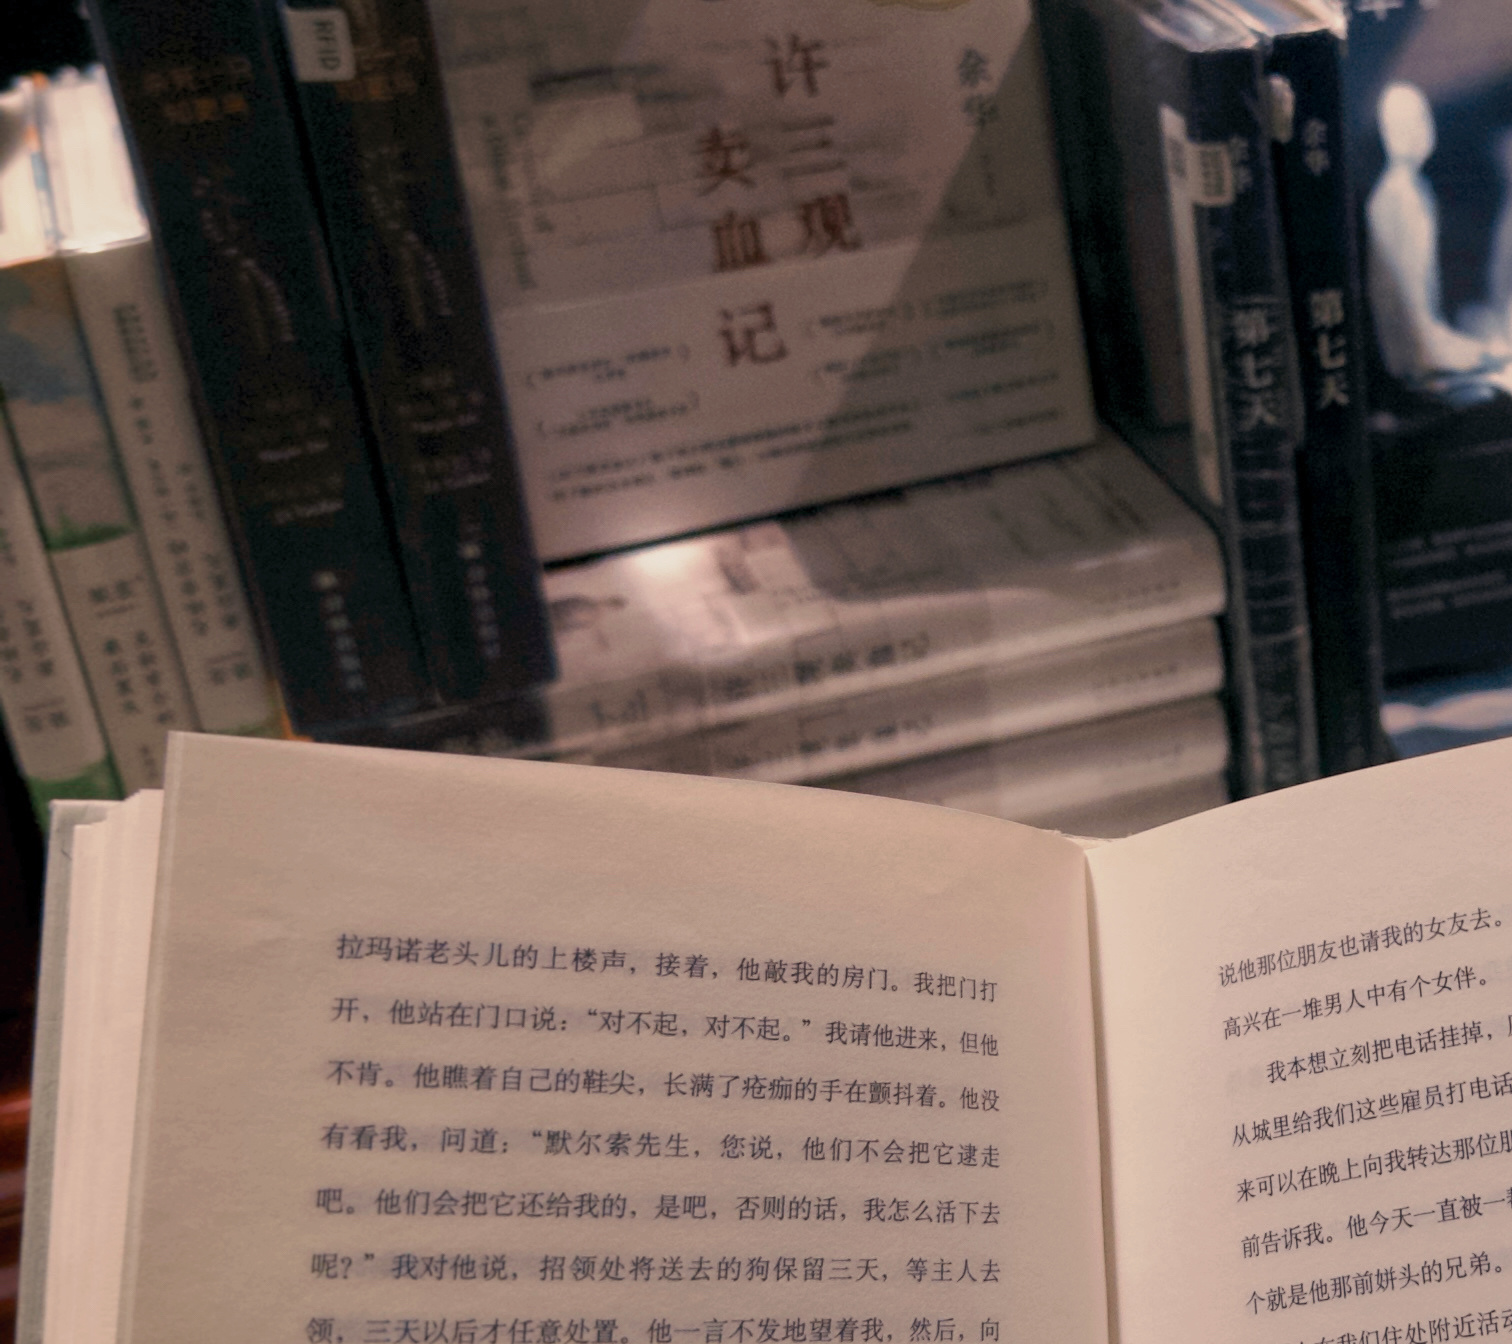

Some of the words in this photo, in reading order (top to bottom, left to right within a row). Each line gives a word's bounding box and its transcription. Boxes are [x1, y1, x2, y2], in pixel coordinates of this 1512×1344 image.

[311, 17, 341, 72] RFID
[1308, 288, 1351, 410] 第七天
[336, 932, 998, 1003] 拉玛诺老头儿的上楼声，接着，他敲我的房门。我把门打
[330, 997, 1000, 1058] 开，他站在门口说：“对不起，对不起。”我请他进来，但他
[1222, 964, 1489, 1040] 高兴在一堆男人中有个女伴。
[327, 1059, 1001, 1113] 不肯。他瞧着自己的鞋尖，长满了疮痂的手在颤抖着。他没
[320, 1122, 1001, 1169] 有看我，问道：“默尔索先生，您说，他们不会把它逮走
[316, 1187, 1001, 1226] 吧。他们会把它还给我的，是吧，否则的话，我怎么活下去
[310, 1252, 1001, 1284] 呢？”我对他说，招领处将送去的狗保留三天，等主人去
[305, 1316, 1001, 1344] 领，三天以后才任意处置。他一言不发地望着我，然后，向
